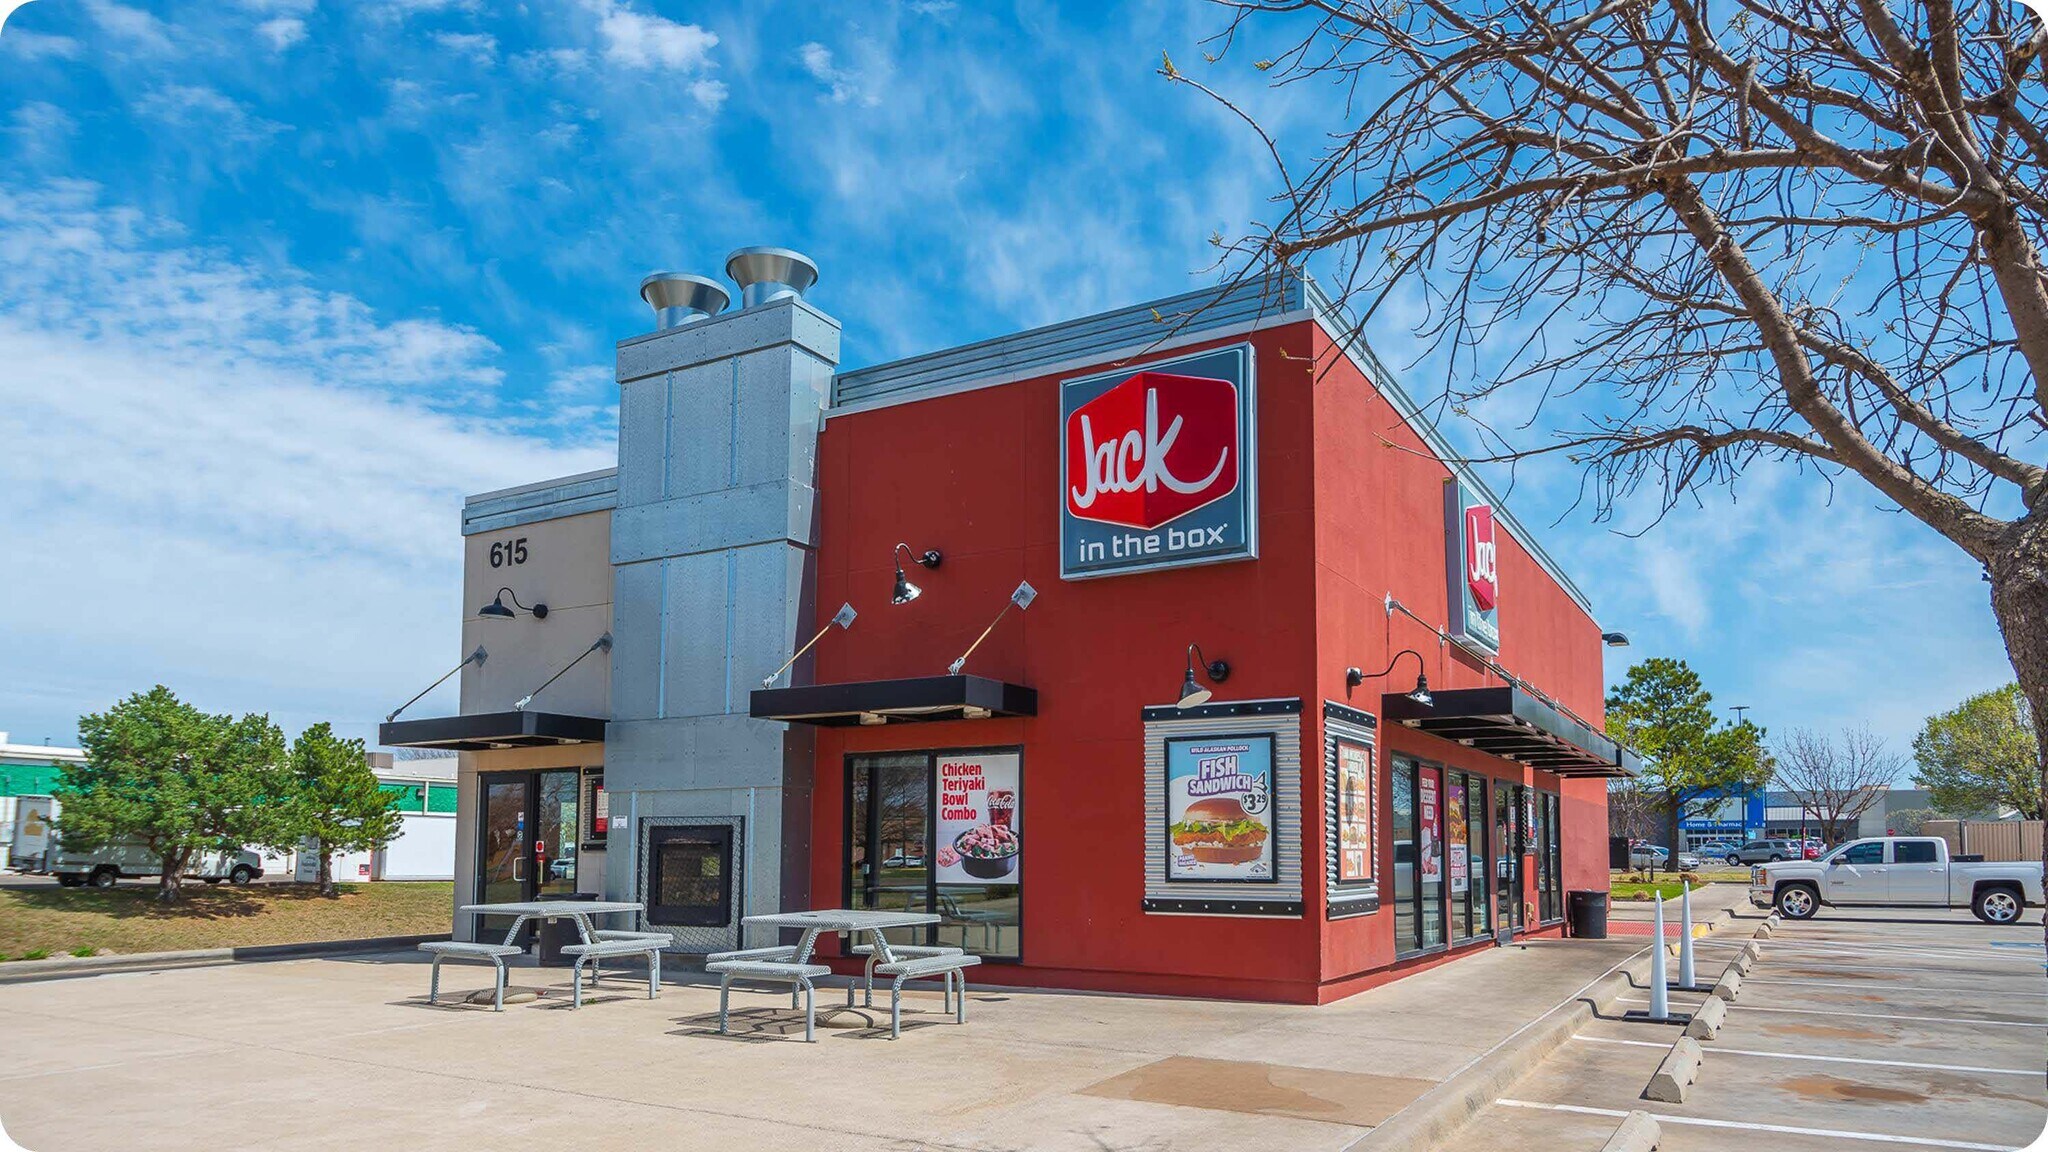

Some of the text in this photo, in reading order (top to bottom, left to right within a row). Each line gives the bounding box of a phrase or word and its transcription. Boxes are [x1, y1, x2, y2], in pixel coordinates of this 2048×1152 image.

[1072, 388, 1228, 509] Jack
[1079, 525, 1225, 562] in the box
[490, 538, 528, 568] 615
[942, 763, 981, 776] Chicken
[1201, 756, 1237, 779] FISH
[942, 777, 985, 792] Teriyaki
[1190, 776, 1251, 794] SANDWICH
[942, 793, 968, 805] Bowl
[941, 807, 977, 820] Combo
